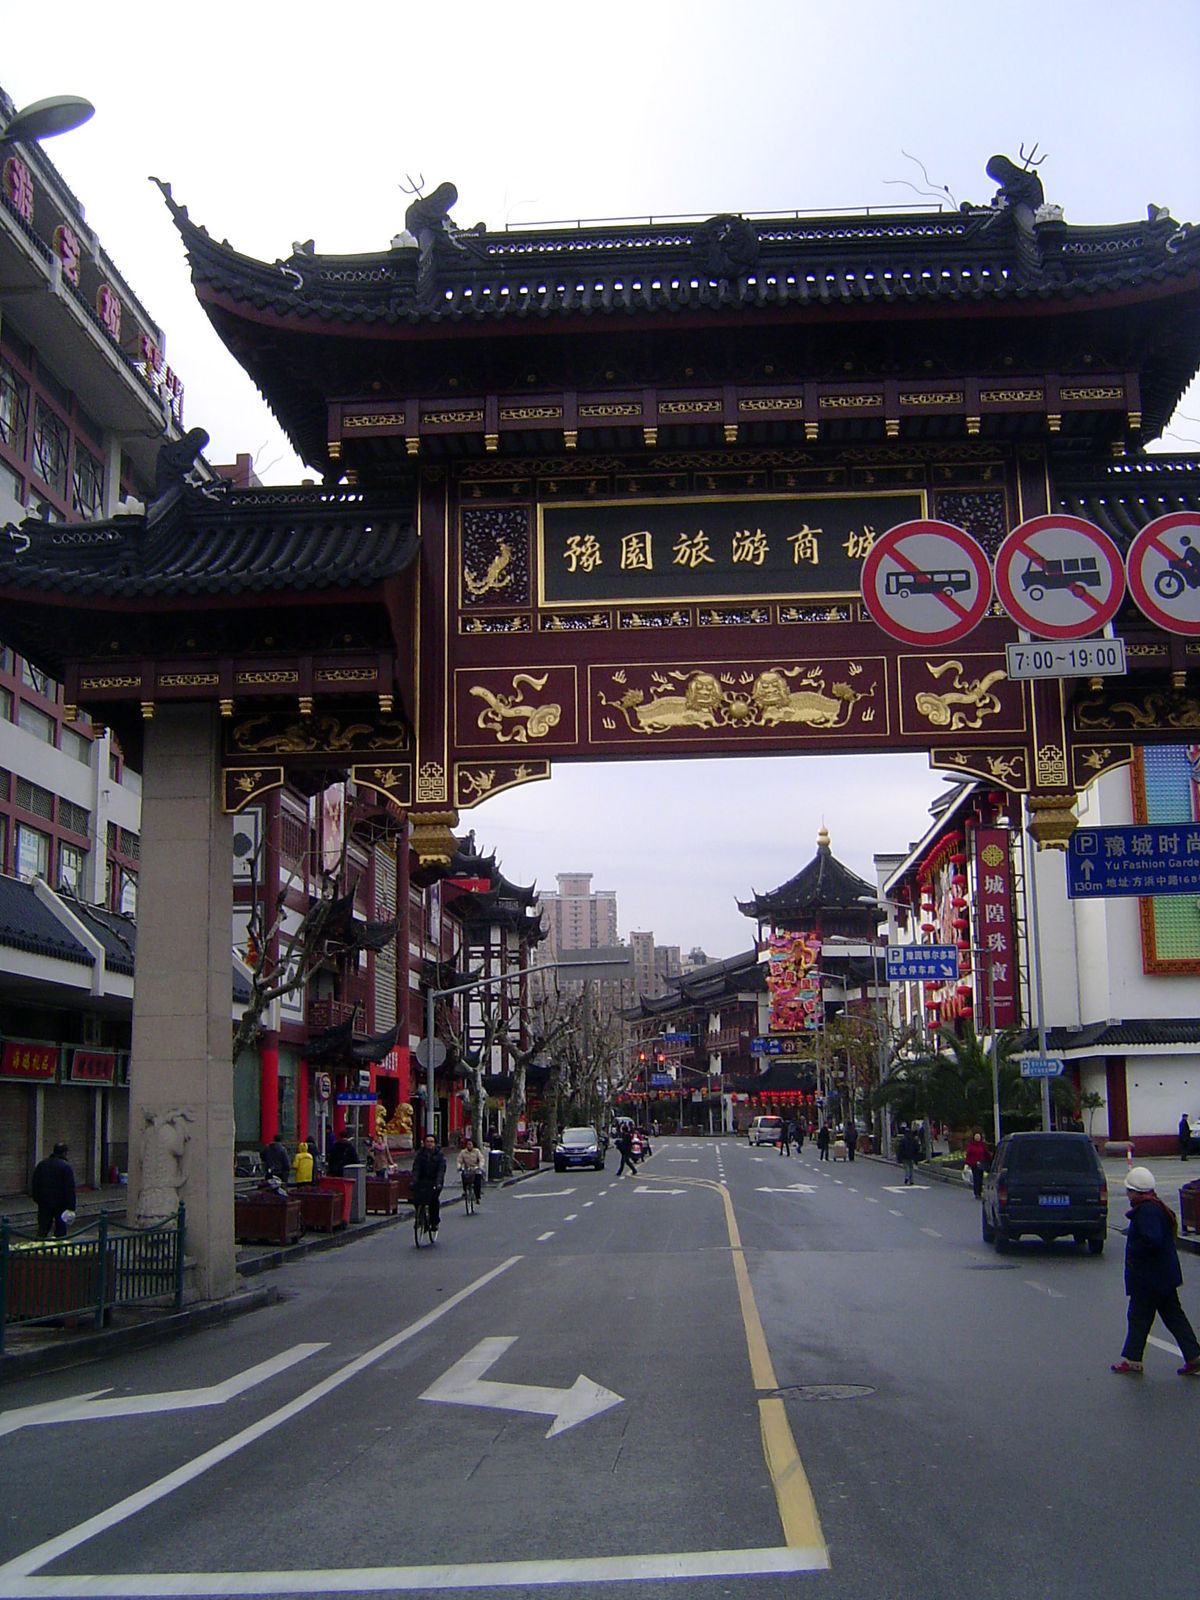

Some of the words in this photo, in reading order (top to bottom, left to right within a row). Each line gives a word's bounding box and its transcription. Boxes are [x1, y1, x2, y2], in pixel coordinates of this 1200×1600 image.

[1015, 647, 1116, 671] 7:00~19:00
[1105, 861, 1119, 870] Yu
[1123, 859, 1165, 869] Fashion
